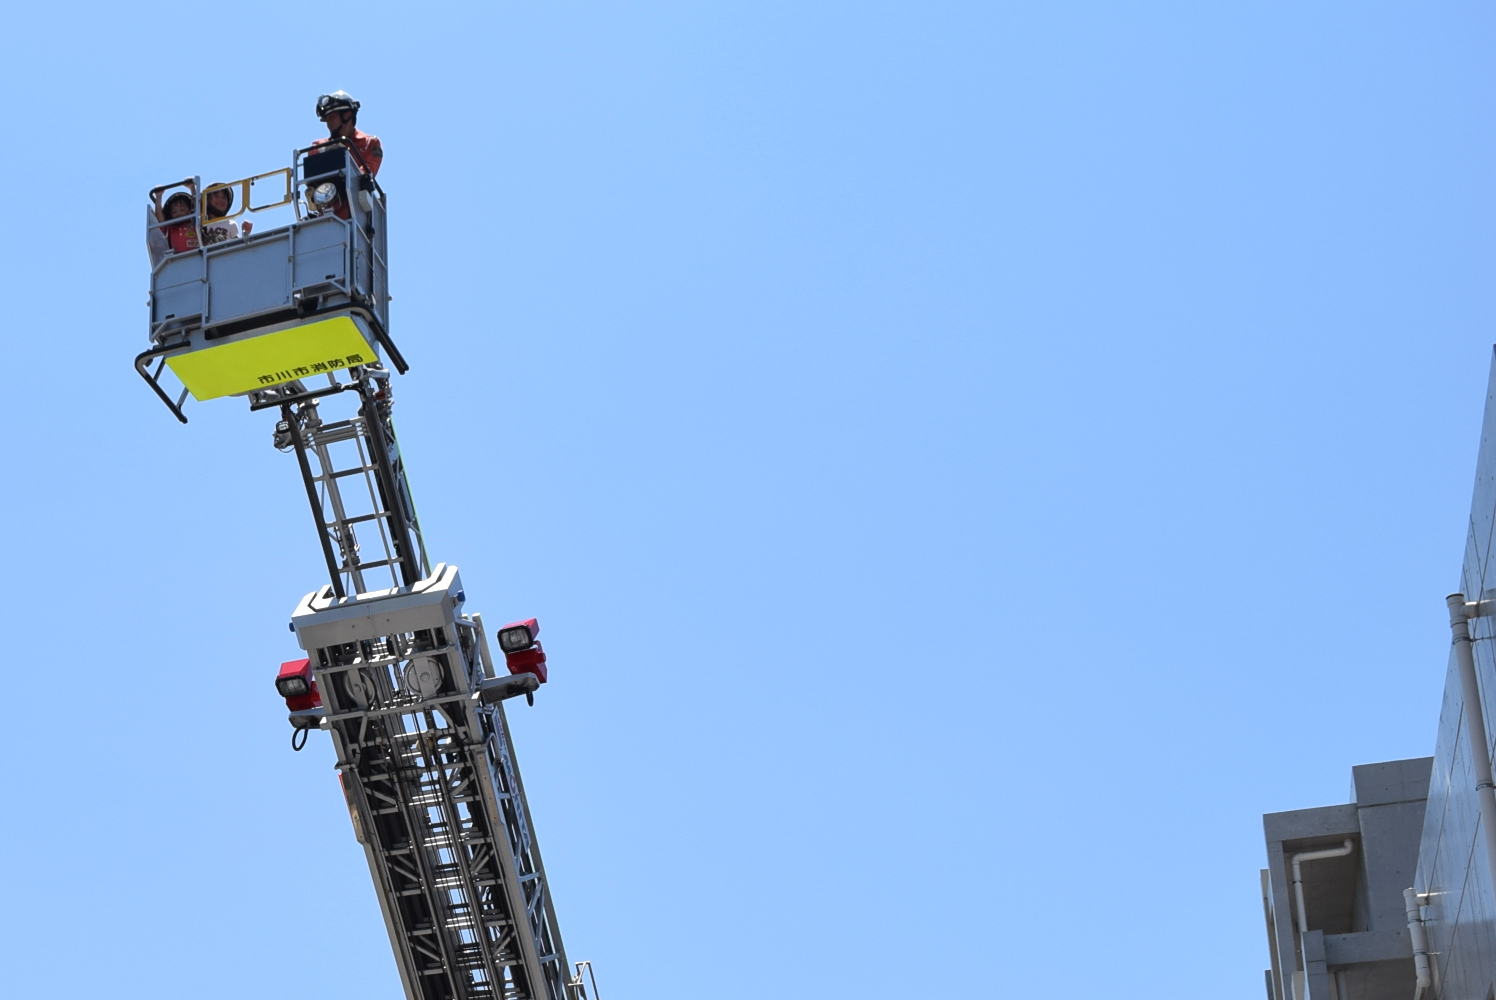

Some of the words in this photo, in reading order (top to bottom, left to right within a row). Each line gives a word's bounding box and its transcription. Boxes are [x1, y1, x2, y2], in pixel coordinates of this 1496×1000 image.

[257, 353, 364, 385] 市川市消防局
